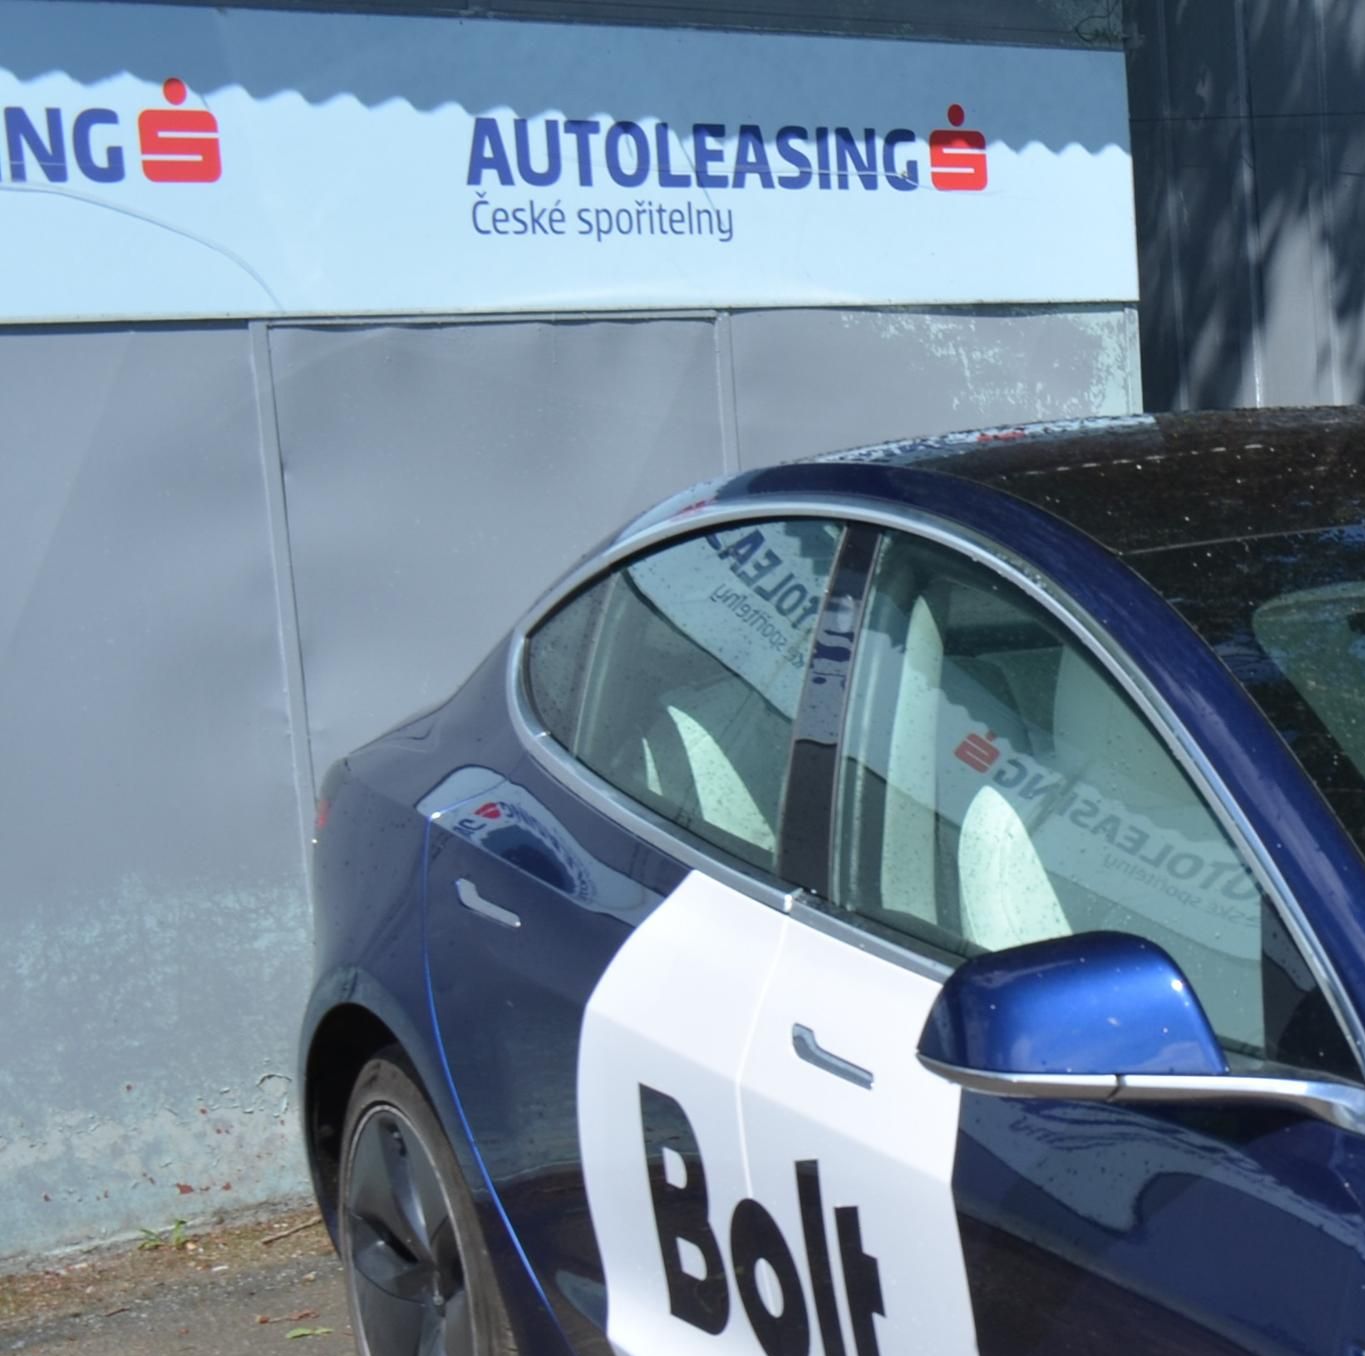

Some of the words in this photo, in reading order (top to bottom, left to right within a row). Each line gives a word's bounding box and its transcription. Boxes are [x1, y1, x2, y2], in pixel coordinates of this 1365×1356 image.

[0, 106, 126, 184] NG
[466, 117, 919, 192] AUTOLEASING
[471, 191, 566, 236] České
[576, 199, 734, 243] spořitelny
